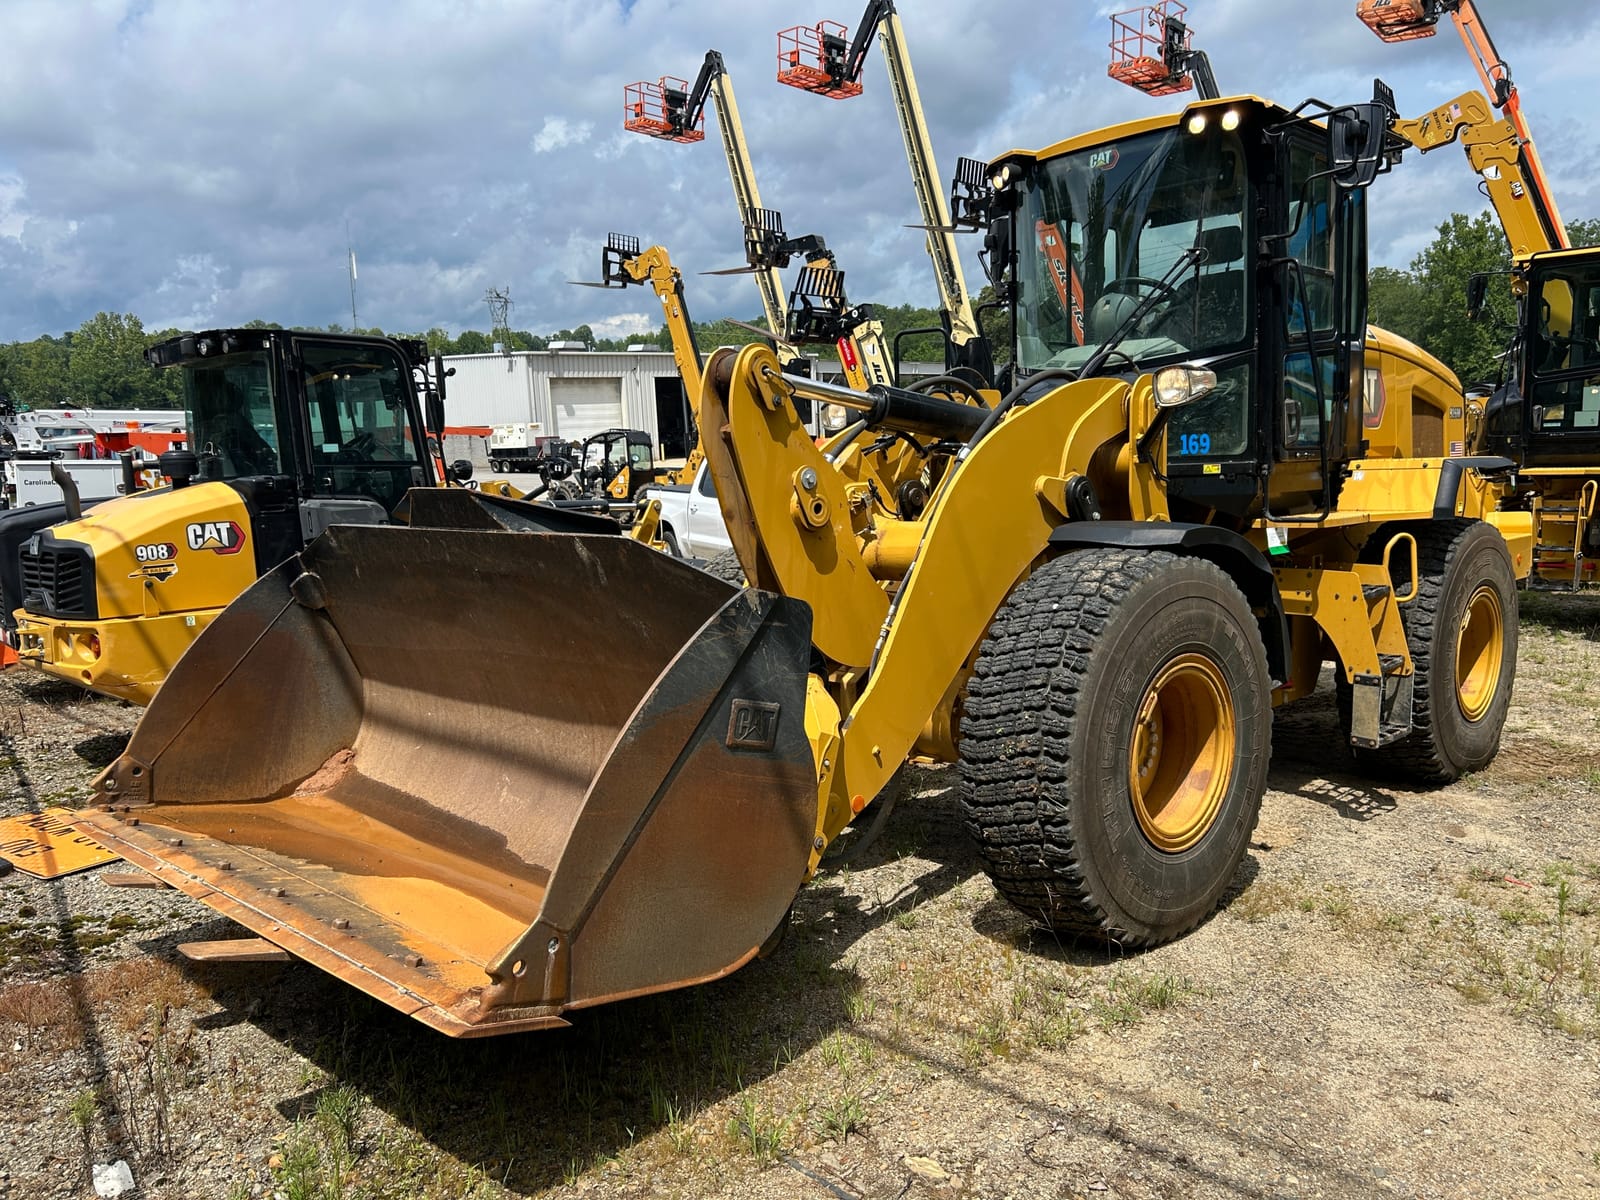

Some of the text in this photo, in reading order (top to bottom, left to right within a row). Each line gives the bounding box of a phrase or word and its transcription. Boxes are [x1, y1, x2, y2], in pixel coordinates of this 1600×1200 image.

[1089, 149, 1112, 169] CAT
[1510, 181, 1524, 197] CAT
[871, 361, 885, 384] JLG
[1179, 433, 1211, 455] 169
[187, 521, 231, 550] CAT
[136, 544, 168, 562] 908
[733, 707, 776, 742] CAT
